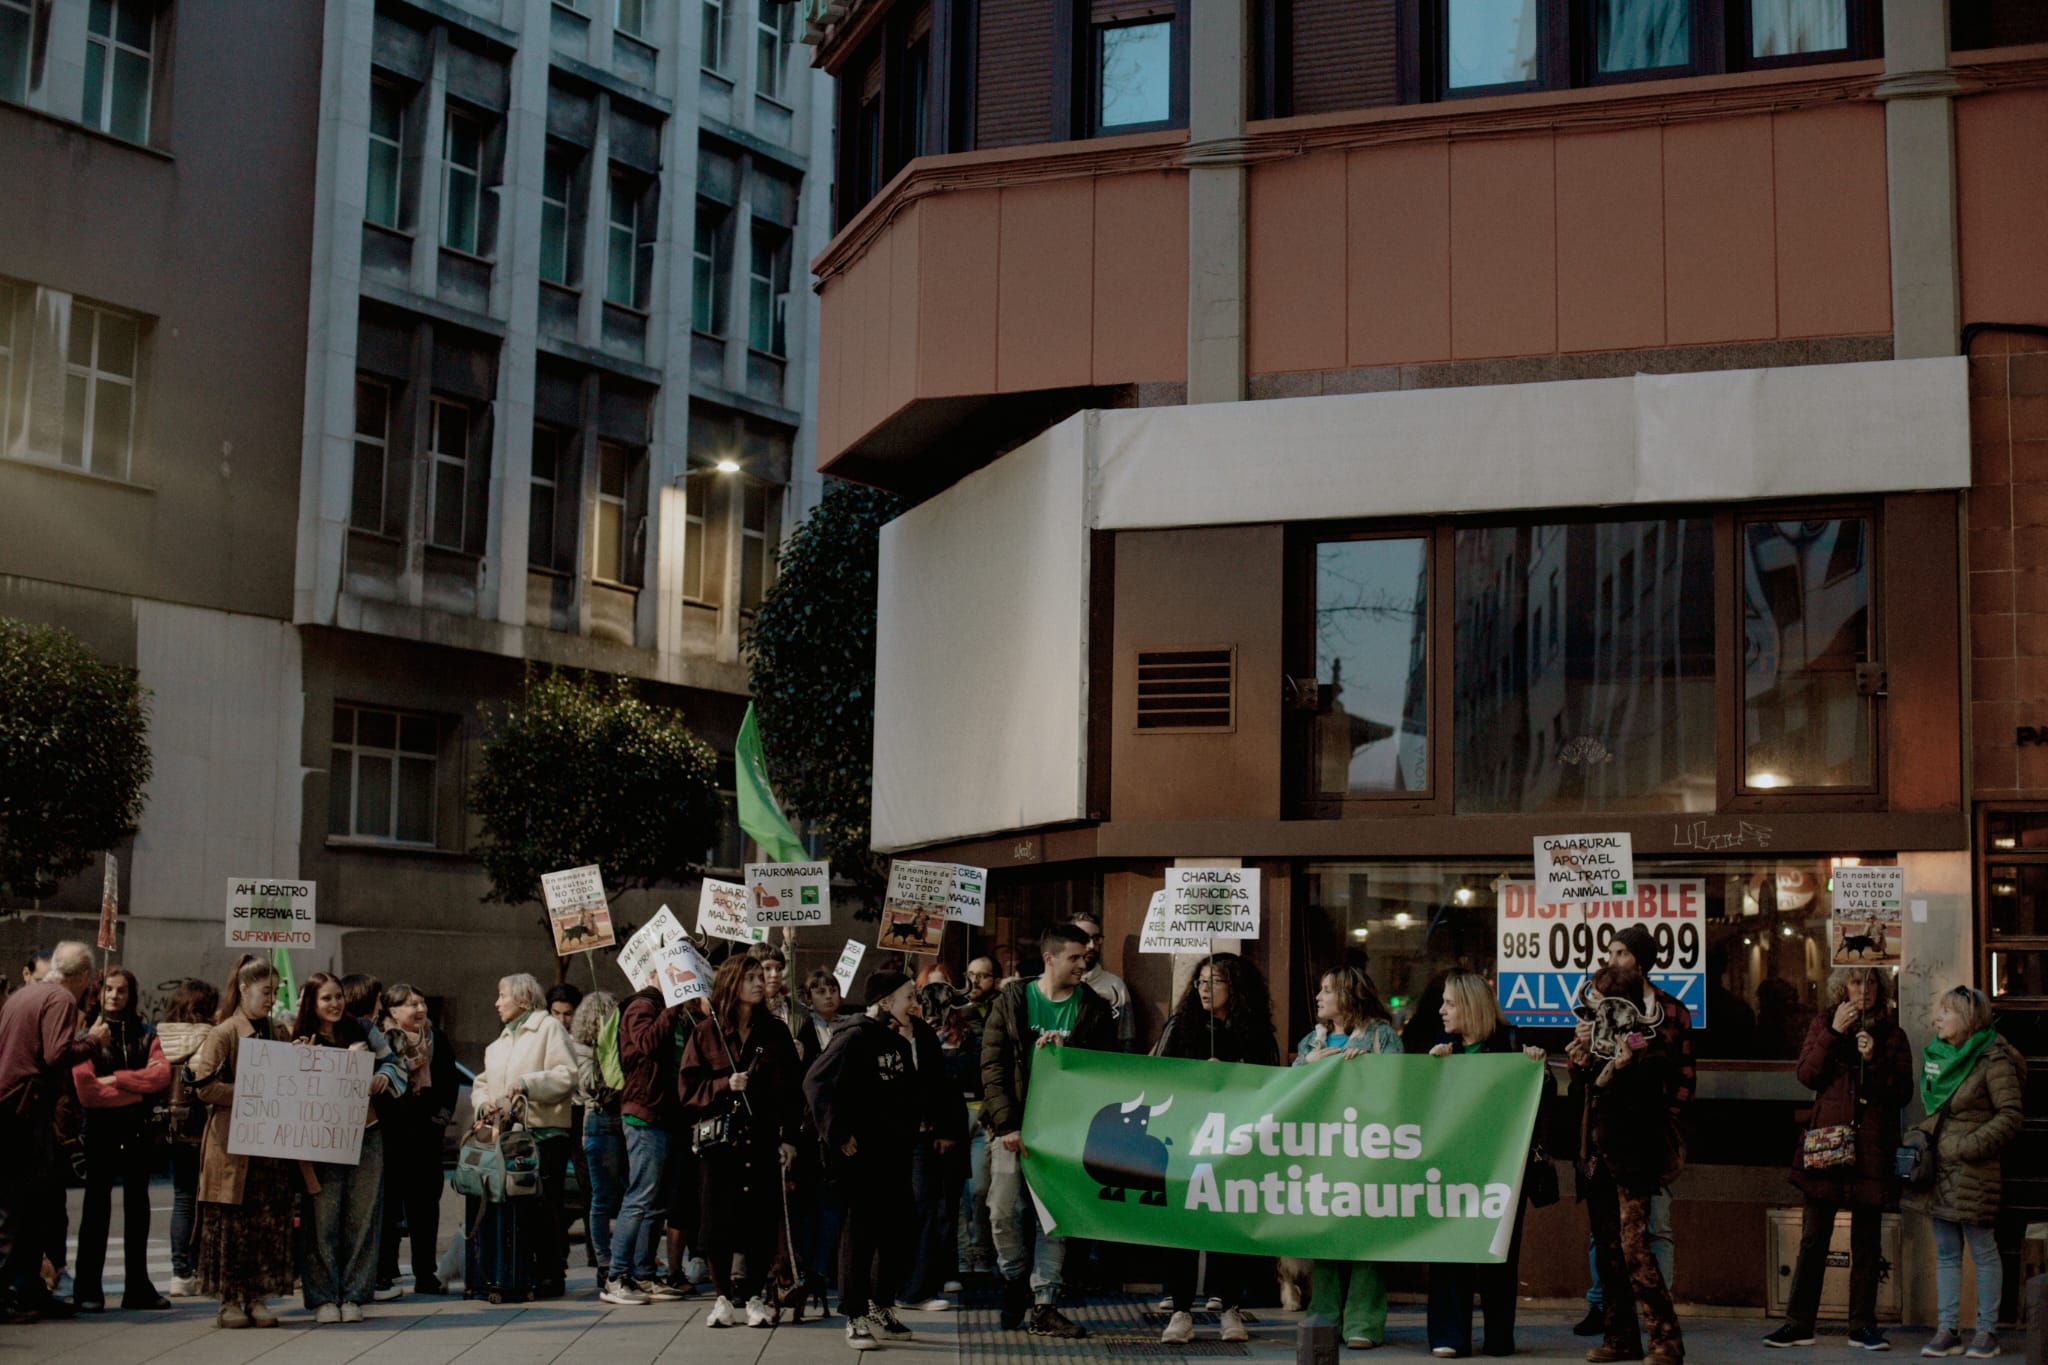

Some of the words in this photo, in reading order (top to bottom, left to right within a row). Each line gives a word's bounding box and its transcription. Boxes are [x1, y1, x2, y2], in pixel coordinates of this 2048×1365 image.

[751, 867, 823, 878] TAUROMAQUIA
[894, 864, 905, 872] En
[907, 867, 937, 877] nombre
[939, 870, 950, 878] de
[958, 867, 983, 880] CREA
[1181, 871, 1242, 883] CHARLAS
[1835, 871, 1848, 879] En
[1851, 871, 1886, 879] nombre
[1889, 871, 1901, 879] de
[562, 879, 594, 889] cultura
[909, 876, 943, 886] cultura
[1842, 880, 1853, 889] la
[1855, 881, 1894, 889] cultura
[260, 884, 308, 897] DENTRO
[554, 890, 567, 898] NO
[570, 885, 594, 895] TODO
[781, 888, 794, 898] ES
[897, 882, 912, 890] NO
[915, 884, 940, 894] TODO
[1562, 886, 1609, 898] ANIMAL
[1843, 890, 1859, 898] NO
[1863, 890, 1893, 898] TODO
[560, 895, 584, 905] VALE
[901, 890, 927, 900] VALE
[948, 893, 981, 907] MAQUIA
[1174, 903, 1251, 916] RESPUESTA
[1848, 900, 1878, 908] VALE
[756, 909, 821, 922] CRUELDAD
[715, 925, 750, 939] ANIMAL
[1169, 920, 1255, 932] ANTITAURINA
[232, 930, 311, 943] SUFRIMIENTO
[1143, 936, 1209, 948] ANTITAURINA
[1503, 932, 1540, 959] 985
[250, 1042, 271, 1067] LA
[298, 1047, 359, 1075] BESTIA
[241, 1074, 265, 1097] NO
[276, 1075, 298, 1097] ES
[306, 1075, 324, 1097] EL
[336, 1078, 367, 1100] TORO
[298, 1101, 341, 1125] TODOS
[348, 1102, 366, 1126] LOS
[236, 1122, 265, 1144] QUE
[273, 1123, 359, 1152] APLAUDEN!
[1188, 1106, 1422, 1159] Asturies
[1183, 1162, 1512, 1219] Antitaurina
